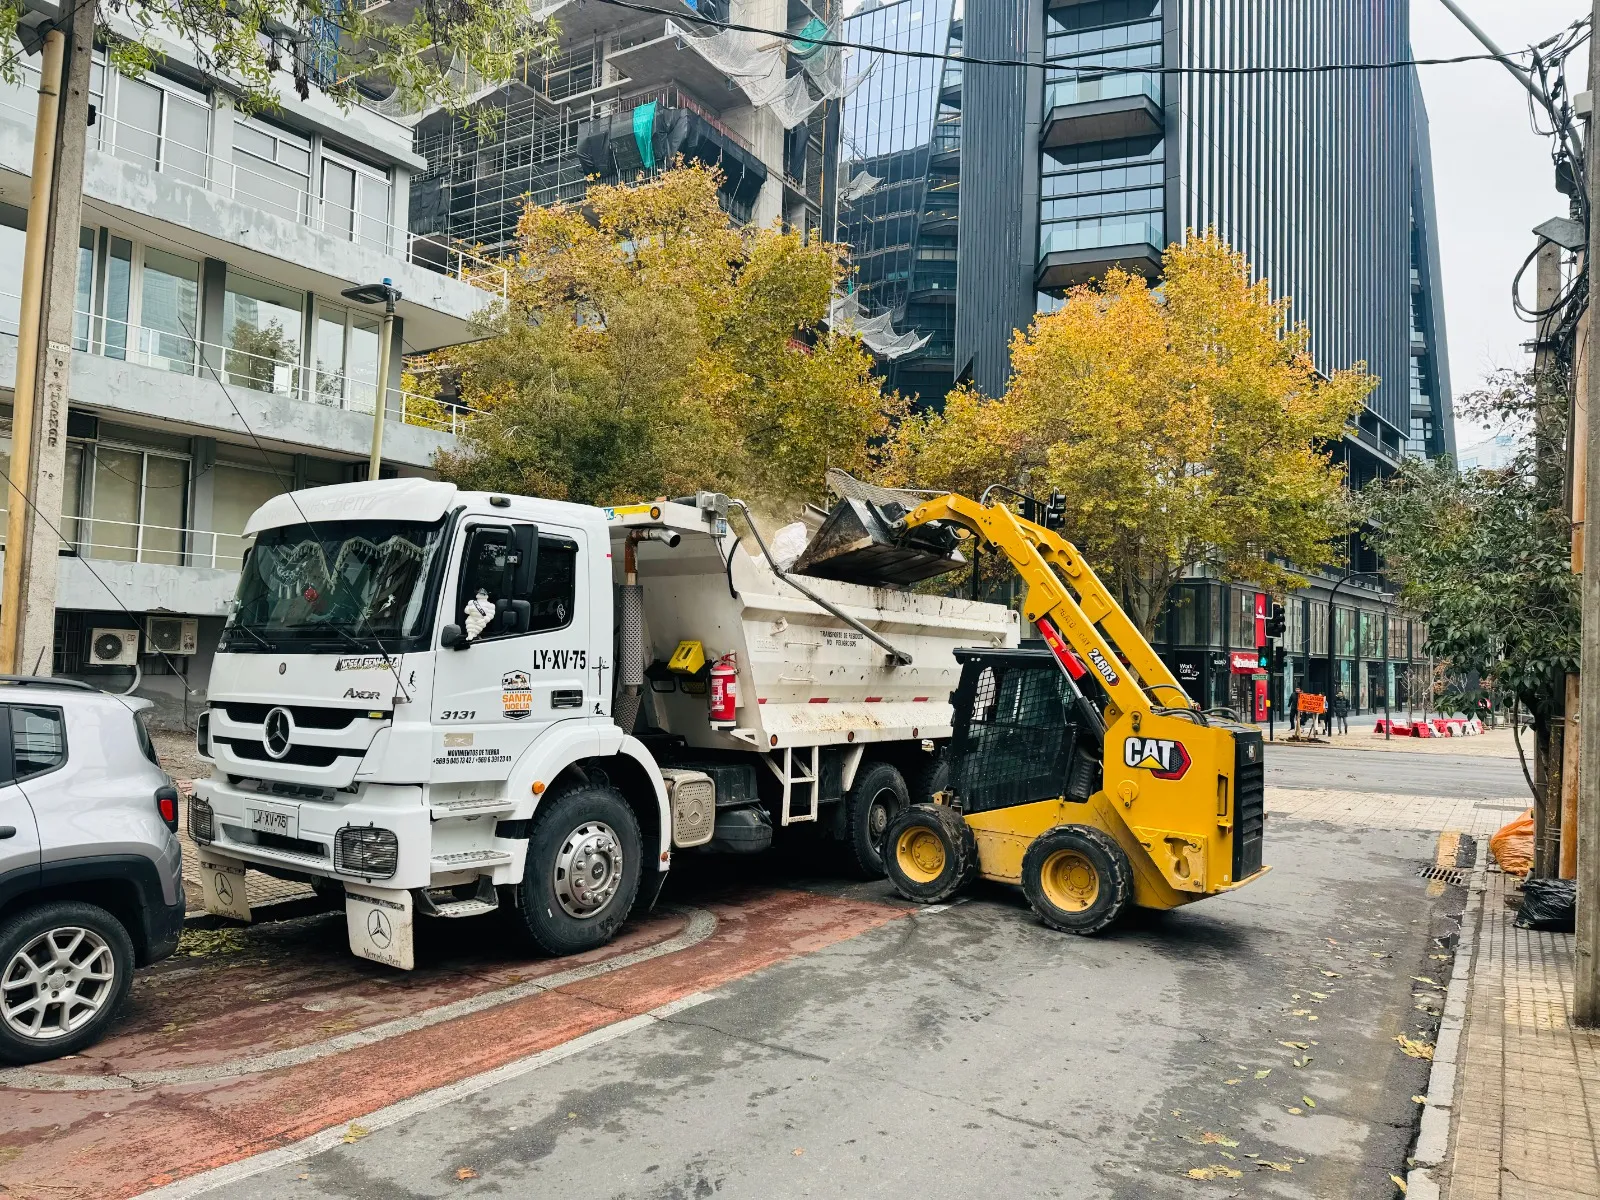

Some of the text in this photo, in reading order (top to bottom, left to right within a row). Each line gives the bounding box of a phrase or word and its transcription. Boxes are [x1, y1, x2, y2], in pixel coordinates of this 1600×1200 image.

[1087, 648, 1117, 682] 246D3
[502, 694, 532, 702] SANTA
[440, 710, 476, 720] 3131
[1125, 737, 1175, 771] CAT
